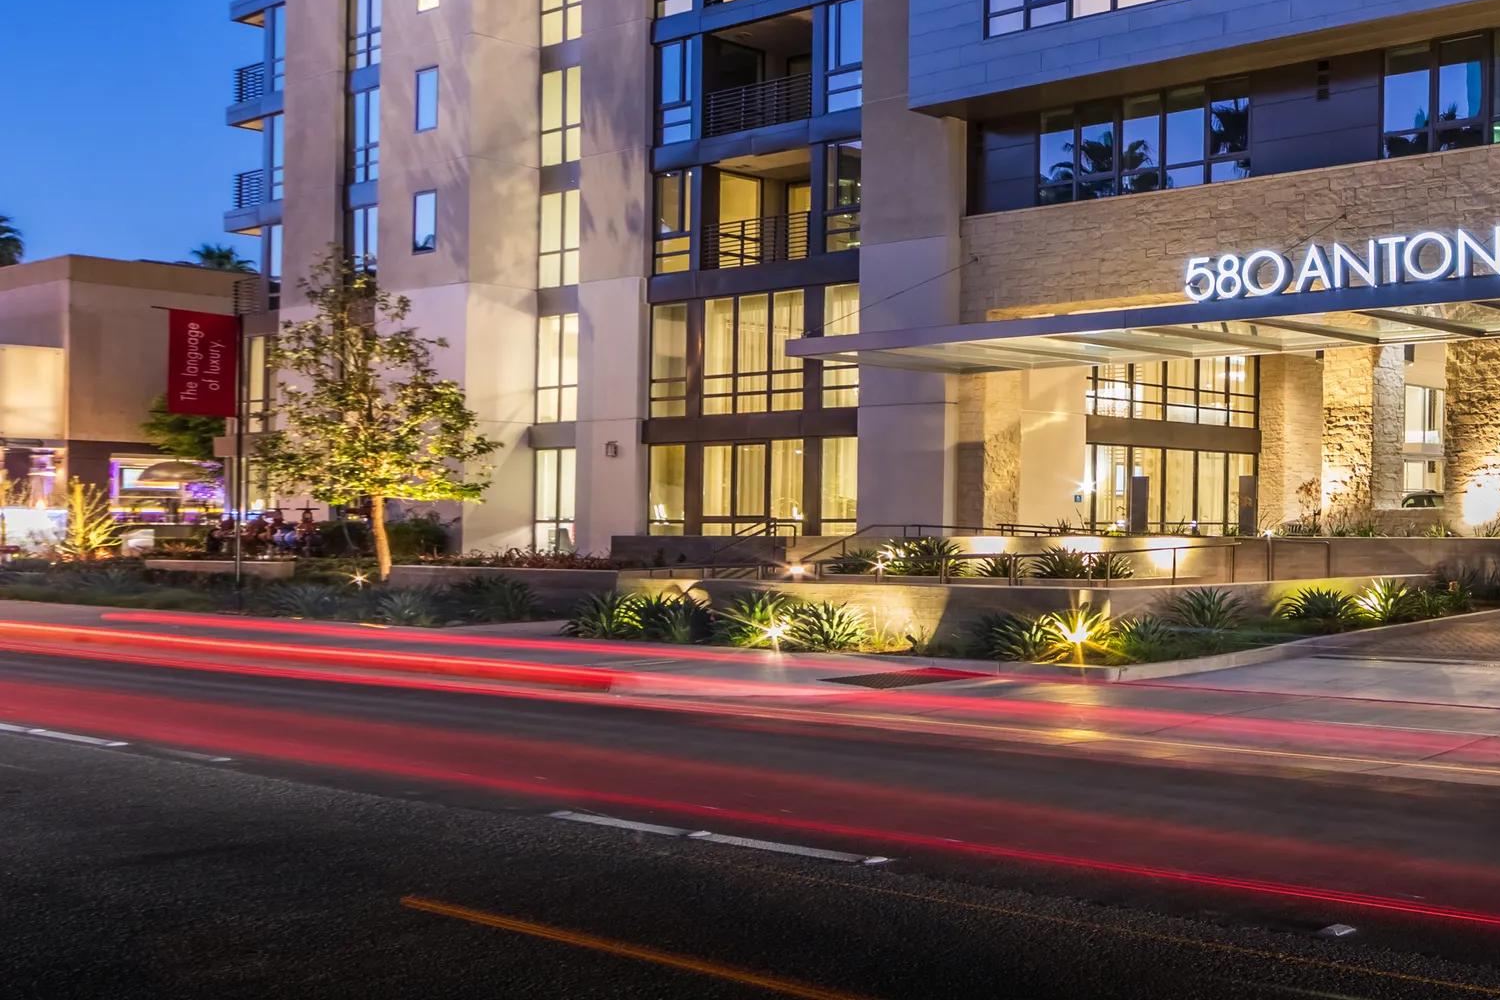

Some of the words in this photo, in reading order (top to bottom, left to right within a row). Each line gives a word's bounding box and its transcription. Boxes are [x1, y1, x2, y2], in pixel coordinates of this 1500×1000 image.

[1185, 249, 1288, 301] 580
[181, 322, 205, 377] language
[180, 381, 198, 400] The
[201, 379, 220, 391] of
